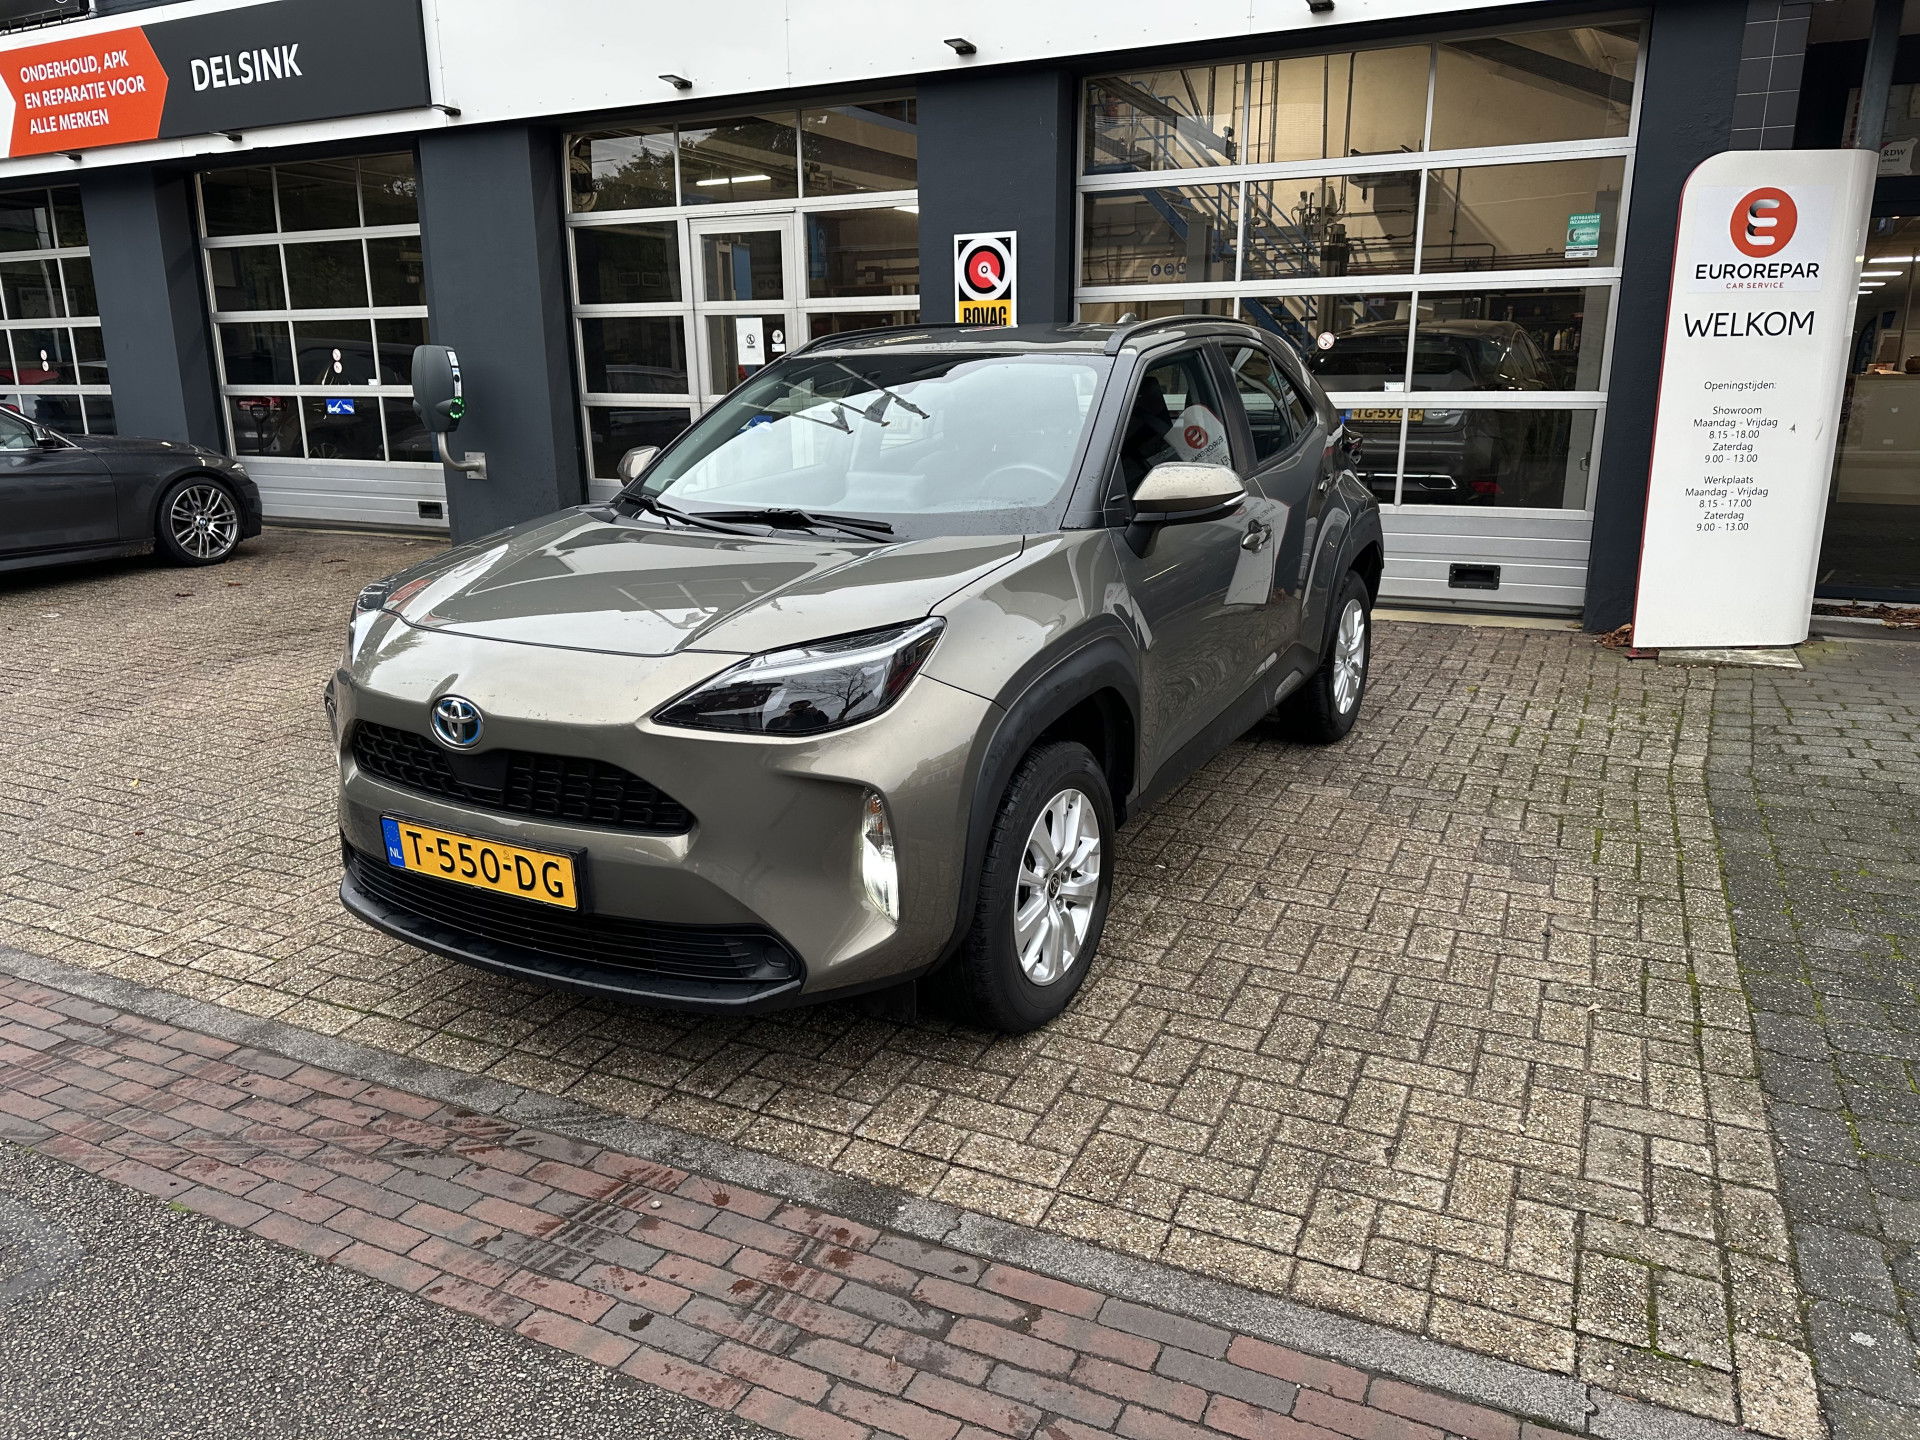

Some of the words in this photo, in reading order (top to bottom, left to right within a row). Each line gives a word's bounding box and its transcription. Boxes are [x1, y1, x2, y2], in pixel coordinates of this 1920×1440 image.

[20, 56, 102, 83] ONDERHOUD,
[103, 50, 129, 69] APK
[190, 43, 303, 92] DELSINK
[24, 92, 41, 109] EN
[43, 82, 109, 107] REPARATIE
[110, 75, 146, 95] VOOR
[29, 116, 57, 135] ALLE
[58, 108, 110, 131] MERKEN
[1695, 262, 1820, 279] EUROREPAR
[1726, 281, 1744, 289] CAR
[963, 306, 1007, 326] BOVAG
[1684, 311, 1814, 337] WELKOM
[1704, 380, 1776, 392] Openingstijden:
[1713, 406, 1762, 415] Showroom
[1694, 418, 1736, 429] Maandag
[1747, 418, 1778, 428] Vrijdag
[1709, 431, 1728, 439] 8.15
[1712, 442, 1753, 453] Zaterdag
[1705, 454, 1723, 463] 9.00
[1734, 454, 1758, 463] 13.00
[1704, 475, 1753, 486] Werkplaats
[1685, 488, 1727, 498] Maandag
[1738, 487, 1768, 497] Vrijdag
[1699, 500, 1718, 508] 8.15
[1729, 499, 1752, 507] 17.00
[1704, 511, 1744, 521] Zaterdag
[1696, 523, 1715, 531] 9.00
[1726, 523, 1748, 531] 13.00
[389, 847, 402, 860] NL
[406, 830, 564, 898] T-550-DG
